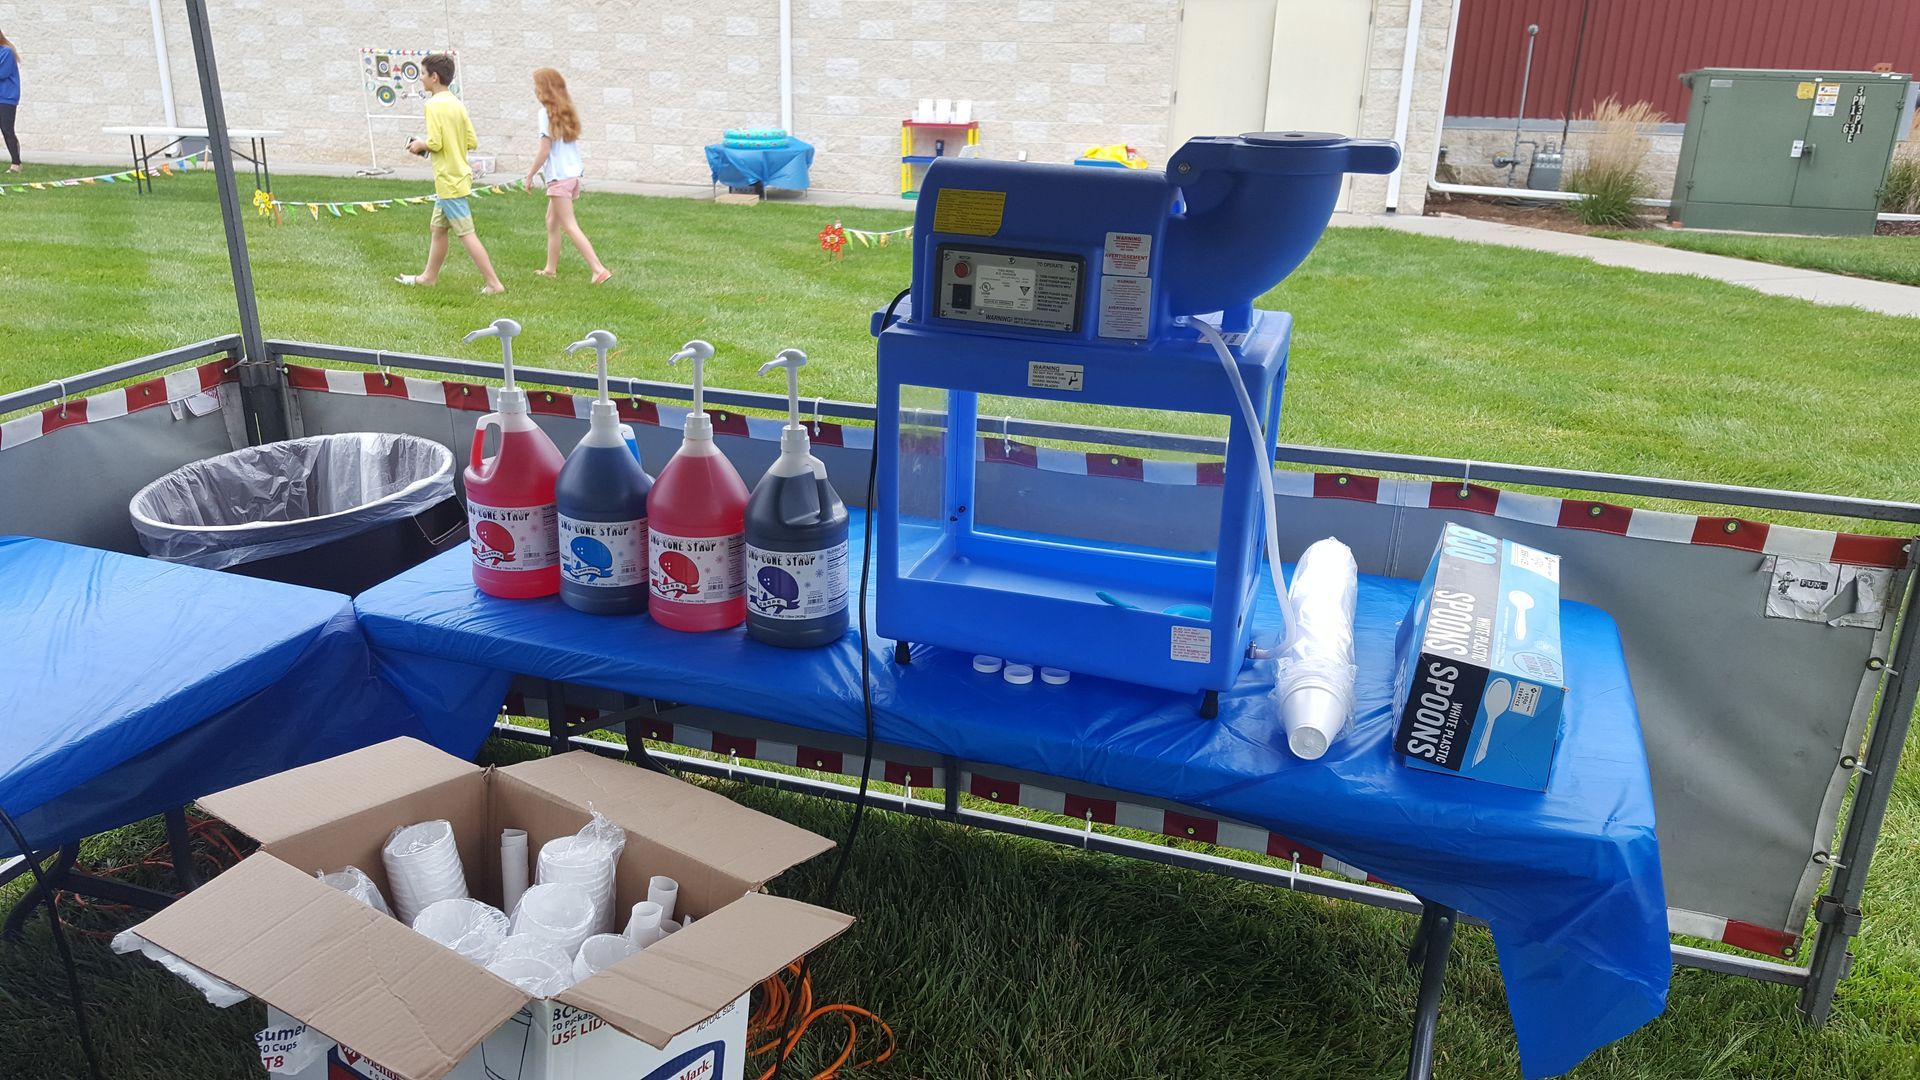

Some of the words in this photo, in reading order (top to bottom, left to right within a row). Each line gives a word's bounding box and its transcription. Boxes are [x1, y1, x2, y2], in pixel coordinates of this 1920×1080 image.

[1857, 86, 1864, 95] 3
[1852, 95, 1867, 105] PM
[1850, 105, 1863, 115] 13
[1842, 124, 1861, 134] 631
[1847, 134, 1854, 143] E
[1104, 253, 1149, 261] AVERTISSEMENT
[985, 314, 1014, 323] WARNING!
[1032, 364, 1060, 372] WARNING
[501, 509, 530, 521] SYRUP
[600, 525, 629, 536] SYRUP
[687, 540, 717, 552] SYRUP
[1444, 525, 1498, 565] 600
[786, 552, 816, 567] SYRUP
[758, 599, 782, 607] GRAPE
[1425, 590, 1476, 656] SPOONS
[1474, 616, 1492, 637] WHITE
[1471, 634, 1490, 662] PLASTIC
[1407, 662, 1459, 758] SPOONS
[1446, 702, 1463, 729] WHITE
[1436, 728, 1455, 764] PLASTIC
[696, 1013, 722, 1033] ACTUAL
[722, 1001, 736, 1016] SIZE
[552, 1025, 577, 1046] USE
[272, 1041, 298, 1052] Cups
[263, 1055, 284, 1071] T8
